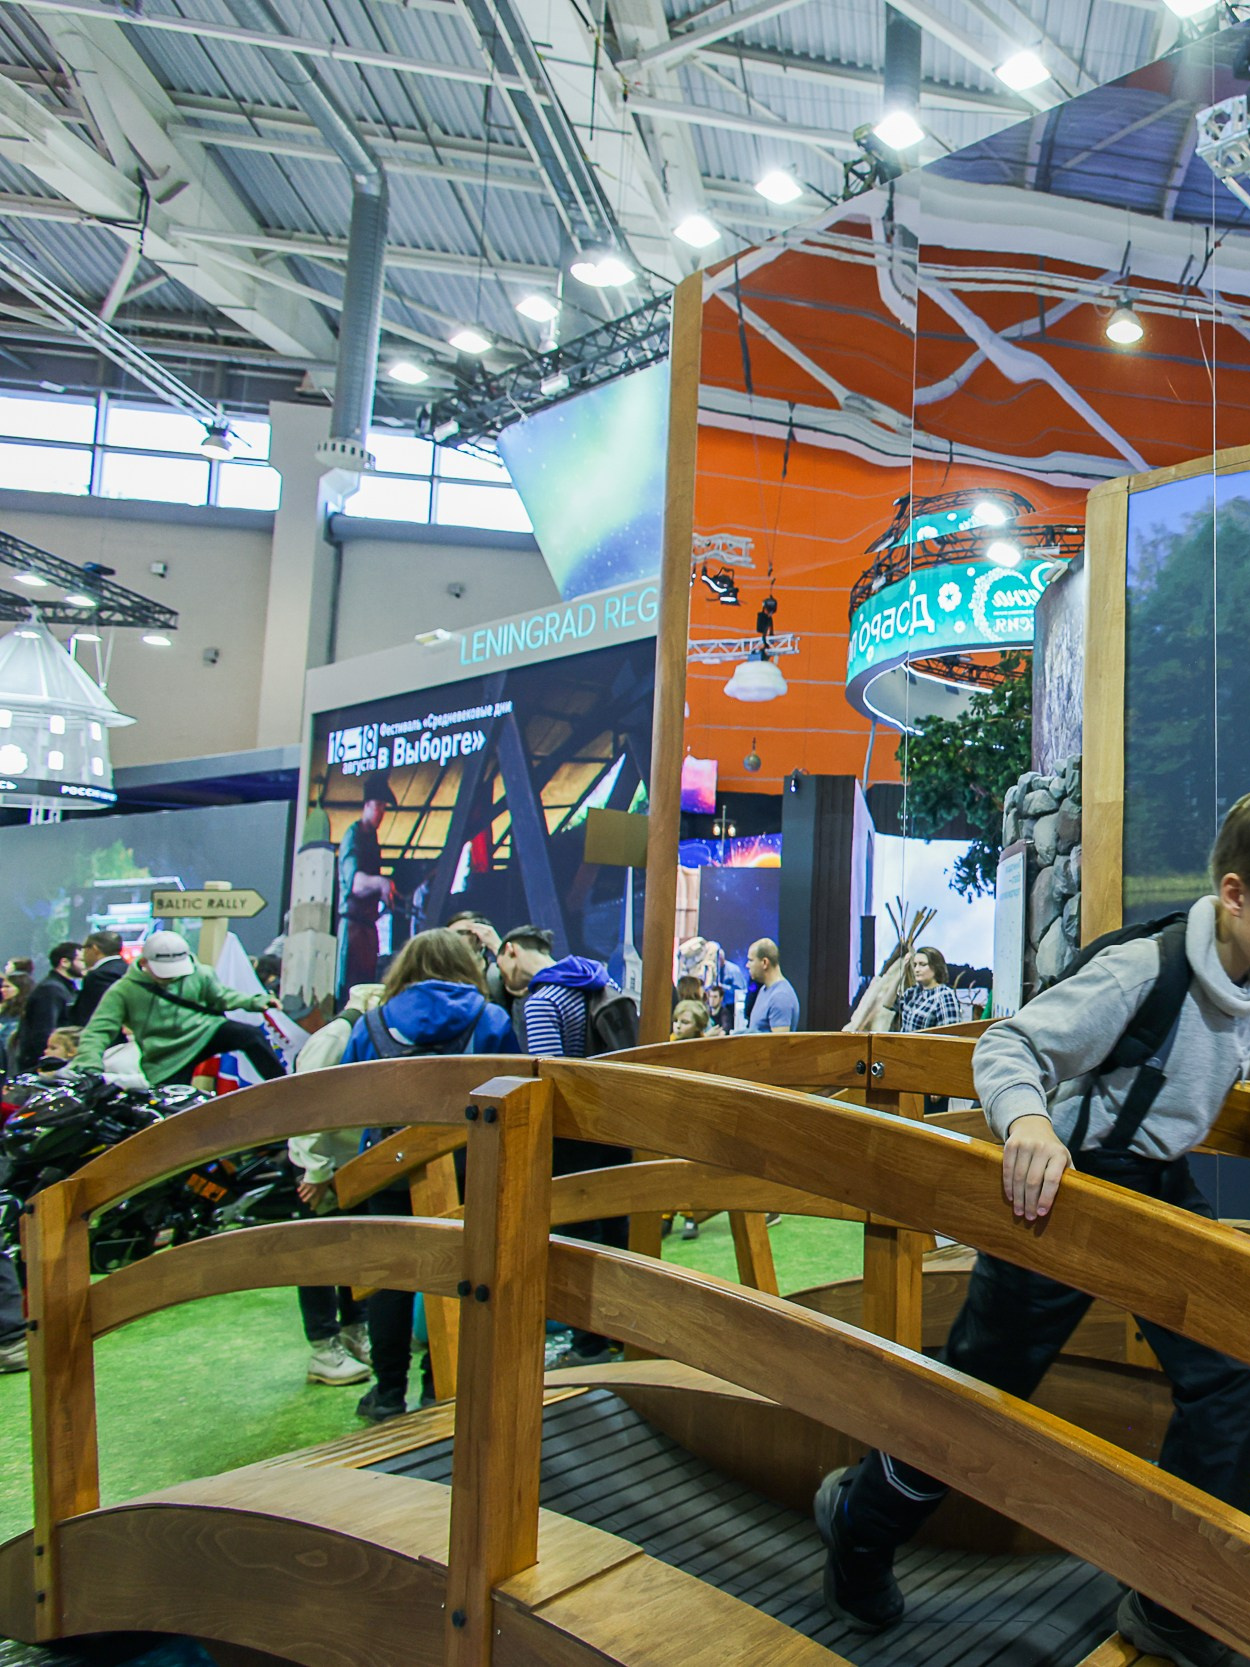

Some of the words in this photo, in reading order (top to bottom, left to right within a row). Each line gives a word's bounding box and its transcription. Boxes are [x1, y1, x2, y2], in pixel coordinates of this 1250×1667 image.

[460, 603, 597, 666] LENINGRAD
[603, 586, 658, 632] REG
[378, 746, 390, 770] в
[392, 729, 487, 768] Выборге»
[342, 757, 377, 777] августа
[156, 898, 203, 910] BALTIC
[206, 898, 248, 910] RALLY
